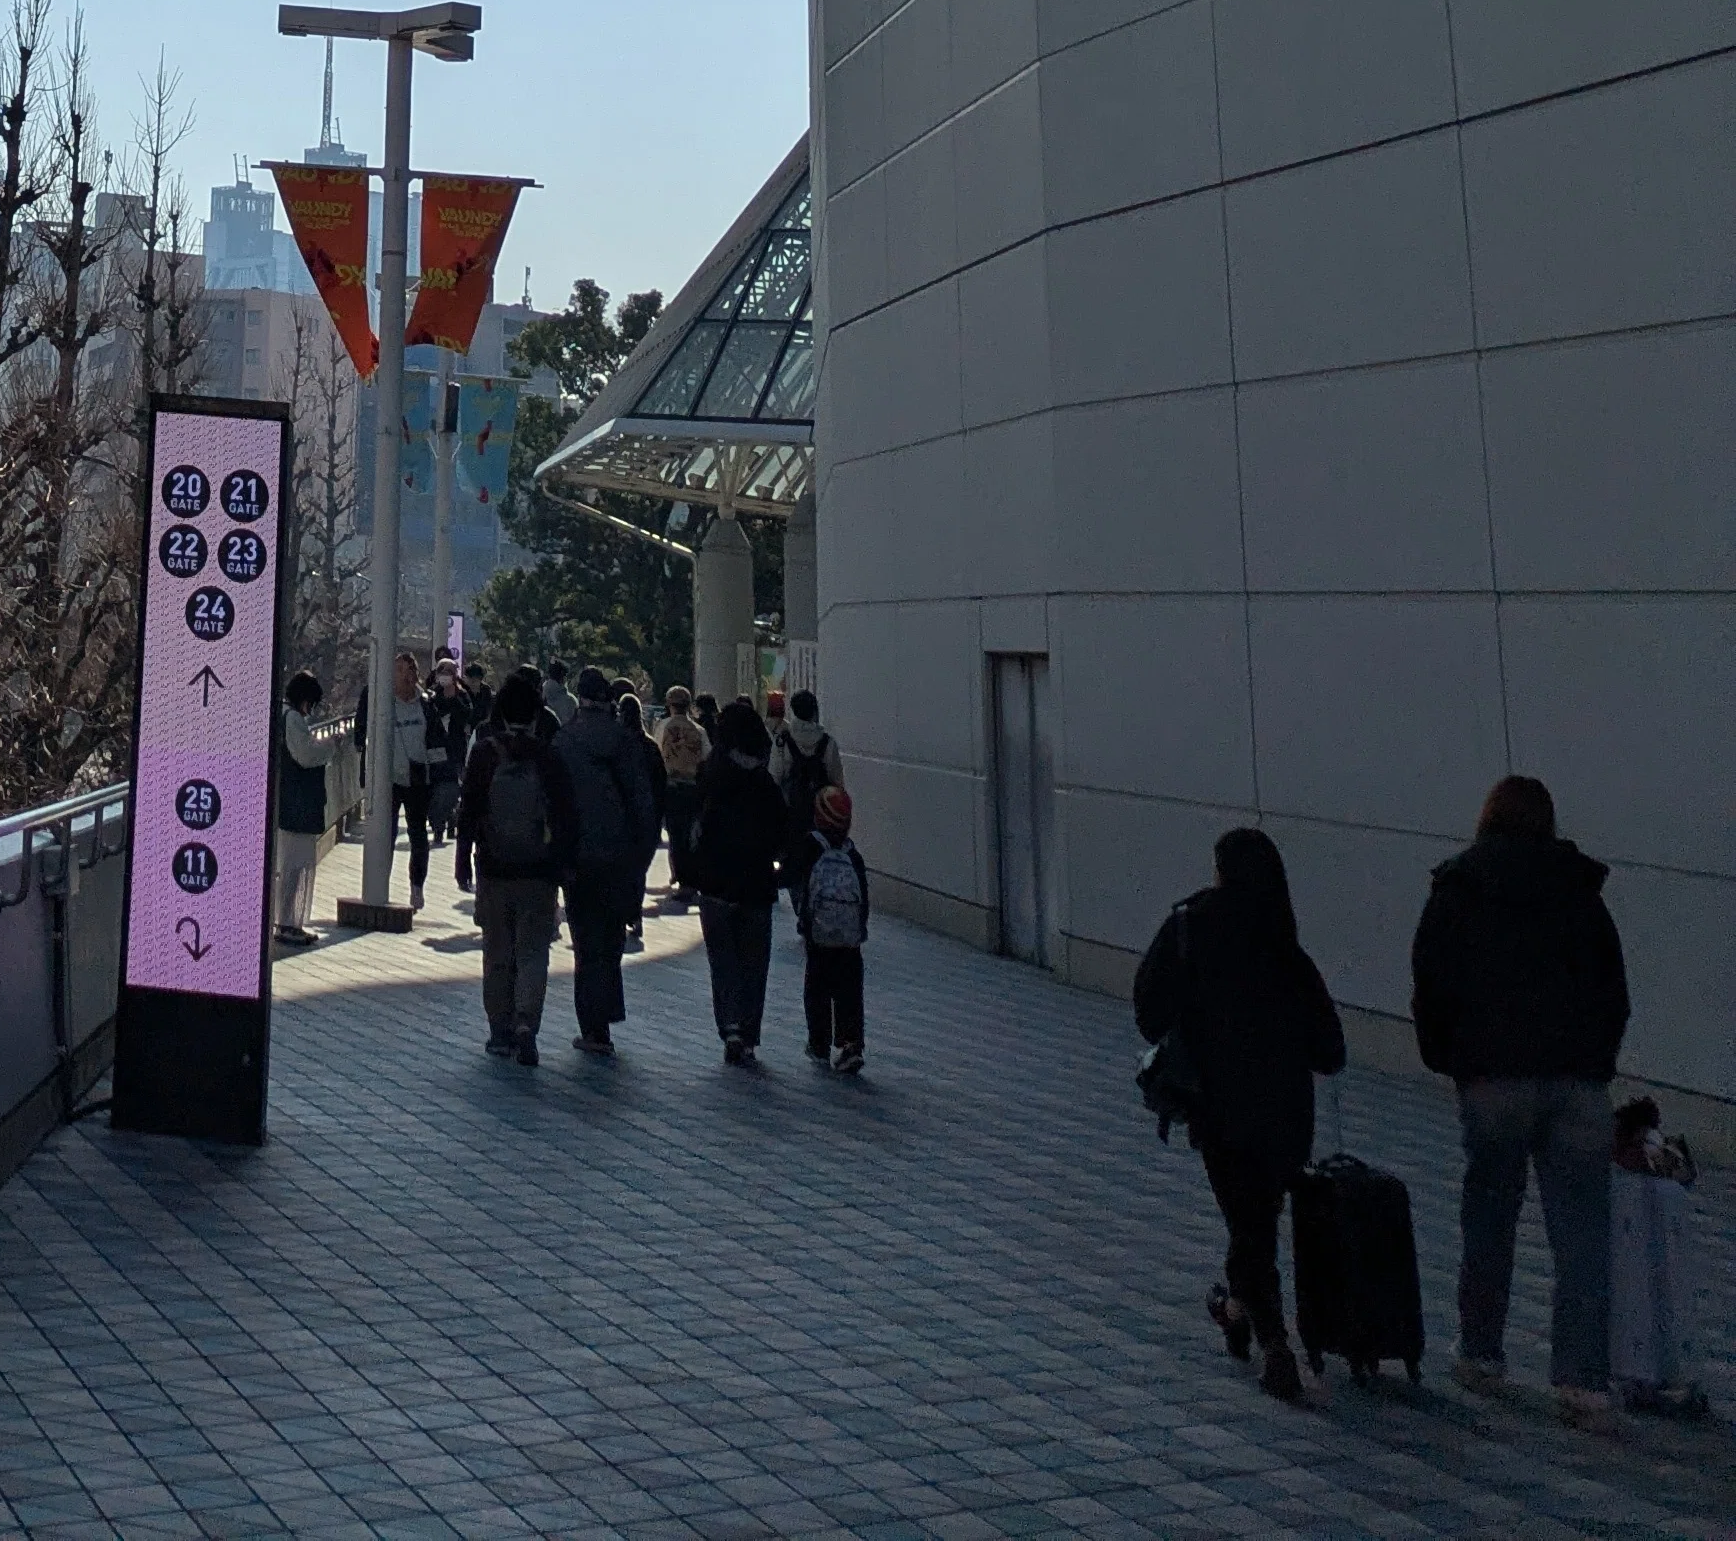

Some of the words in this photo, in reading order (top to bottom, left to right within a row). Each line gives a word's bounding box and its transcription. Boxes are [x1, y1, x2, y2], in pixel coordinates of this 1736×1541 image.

[171, 472, 201, 497] 20
[230, 477, 257, 502] 21
[170, 497, 201, 511] GATE
[228, 502, 259, 516] GATE
[169, 531, 199, 557] 22
[228, 536, 257, 561] 23
[167, 557, 198, 571] GATE
[226, 562, 257, 576] GATE
[194, 593, 226, 619] 24
[193, 620, 225, 634] GATE
[184, 785, 213, 810] 25
[183, 810, 211, 823] GATE
[184, 849, 206, 873] 11
[180, 873, 208, 887] GATE
